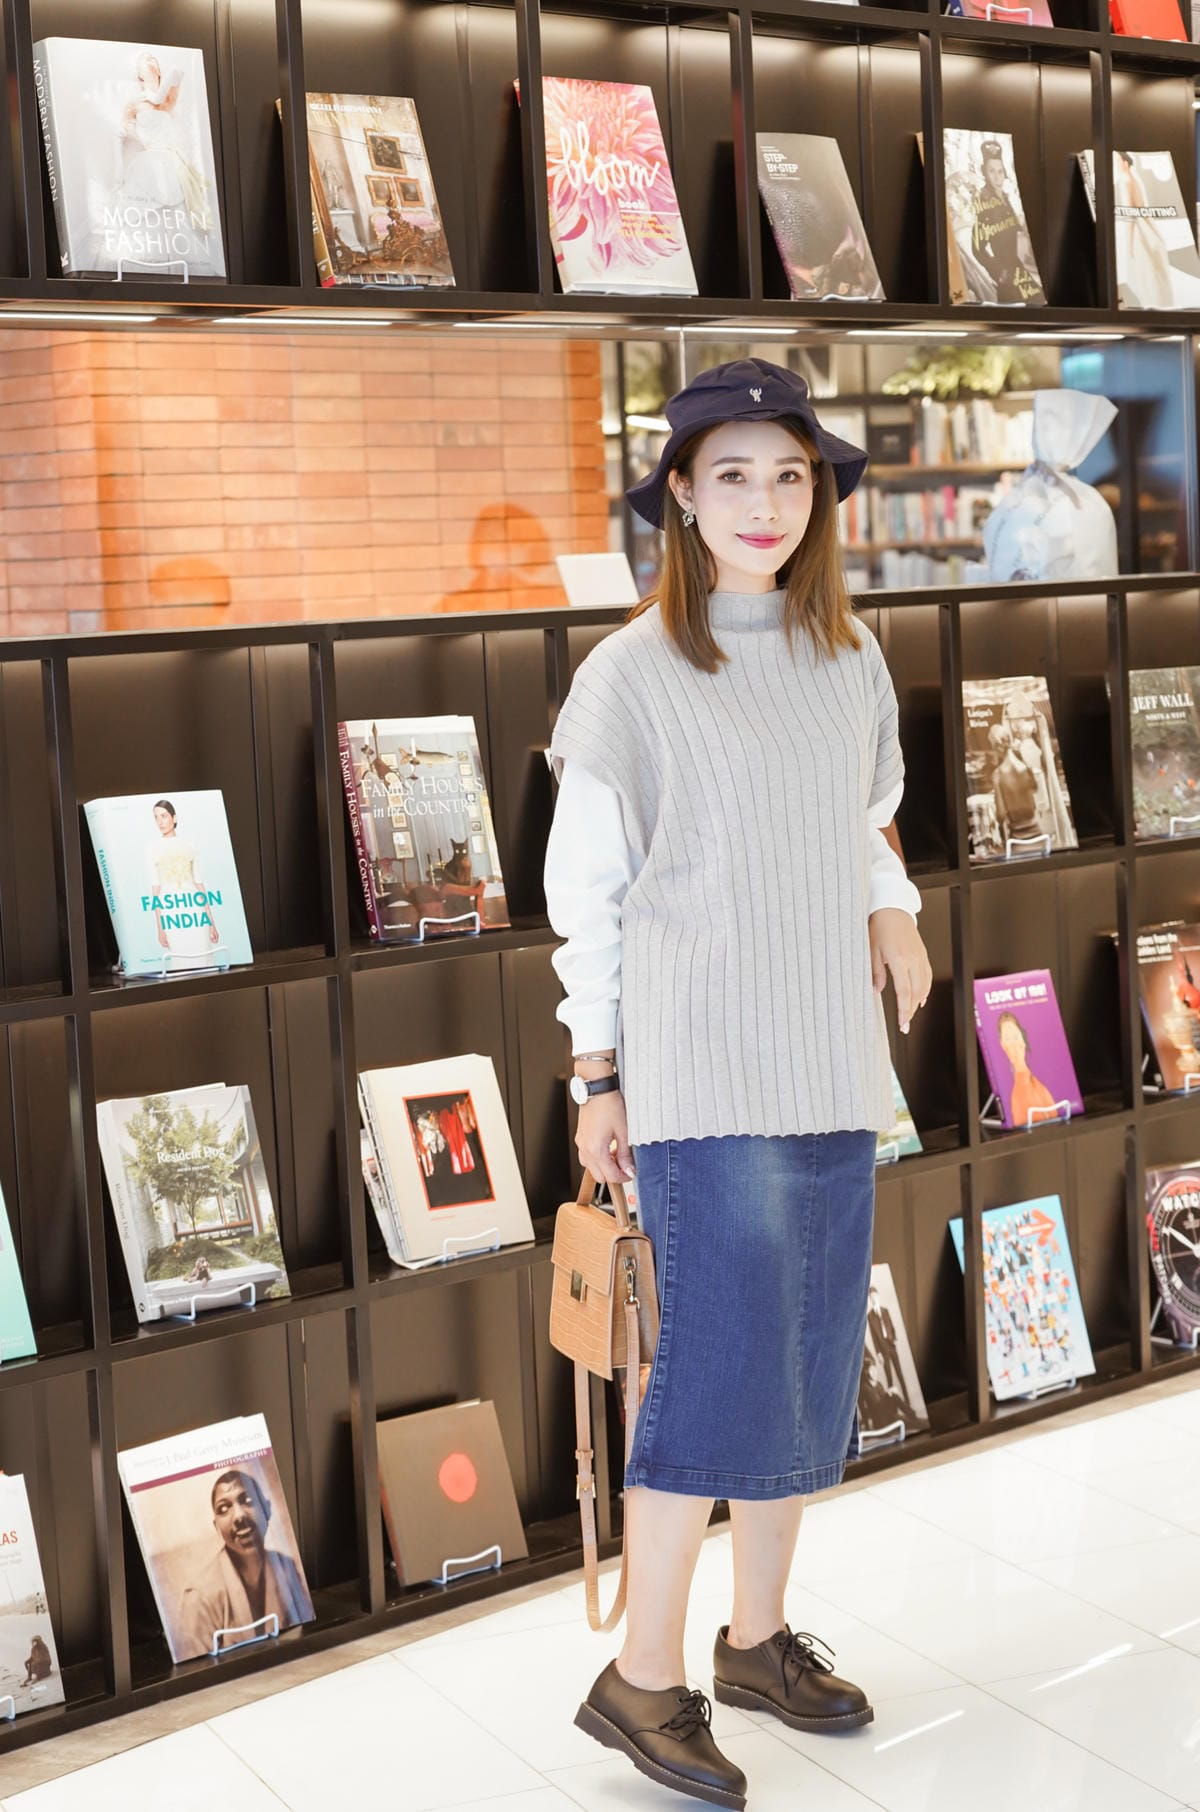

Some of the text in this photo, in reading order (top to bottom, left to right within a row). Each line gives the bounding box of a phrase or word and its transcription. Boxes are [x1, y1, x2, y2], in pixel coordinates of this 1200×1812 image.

[32, 59, 58, 201] MODERN FASHION
[547, 121, 660, 195] bloom
[103, 206, 208, 230] MODERN
[1140, 206, 1177, 217] CUTTING
[104, 230, 210, 256] FASHION
[1133, 693, 1194, 714] JEFF WALL
[340, 750, 353, 789] FAMILY
[360, 775, 484, 799] FAMILY HOUSS
[346, 792, 361, 837] HOUSES
[373, 805, 385, 818] in
[359, 858, 373, 912] COUNTRY
[140, 890, 223, 912] FASHION
[160, 912, 213, 930] INDIA
[157, 1146, 227, 1164] Resident Dog
[1161, 1191, 1200, 1212] WATC
